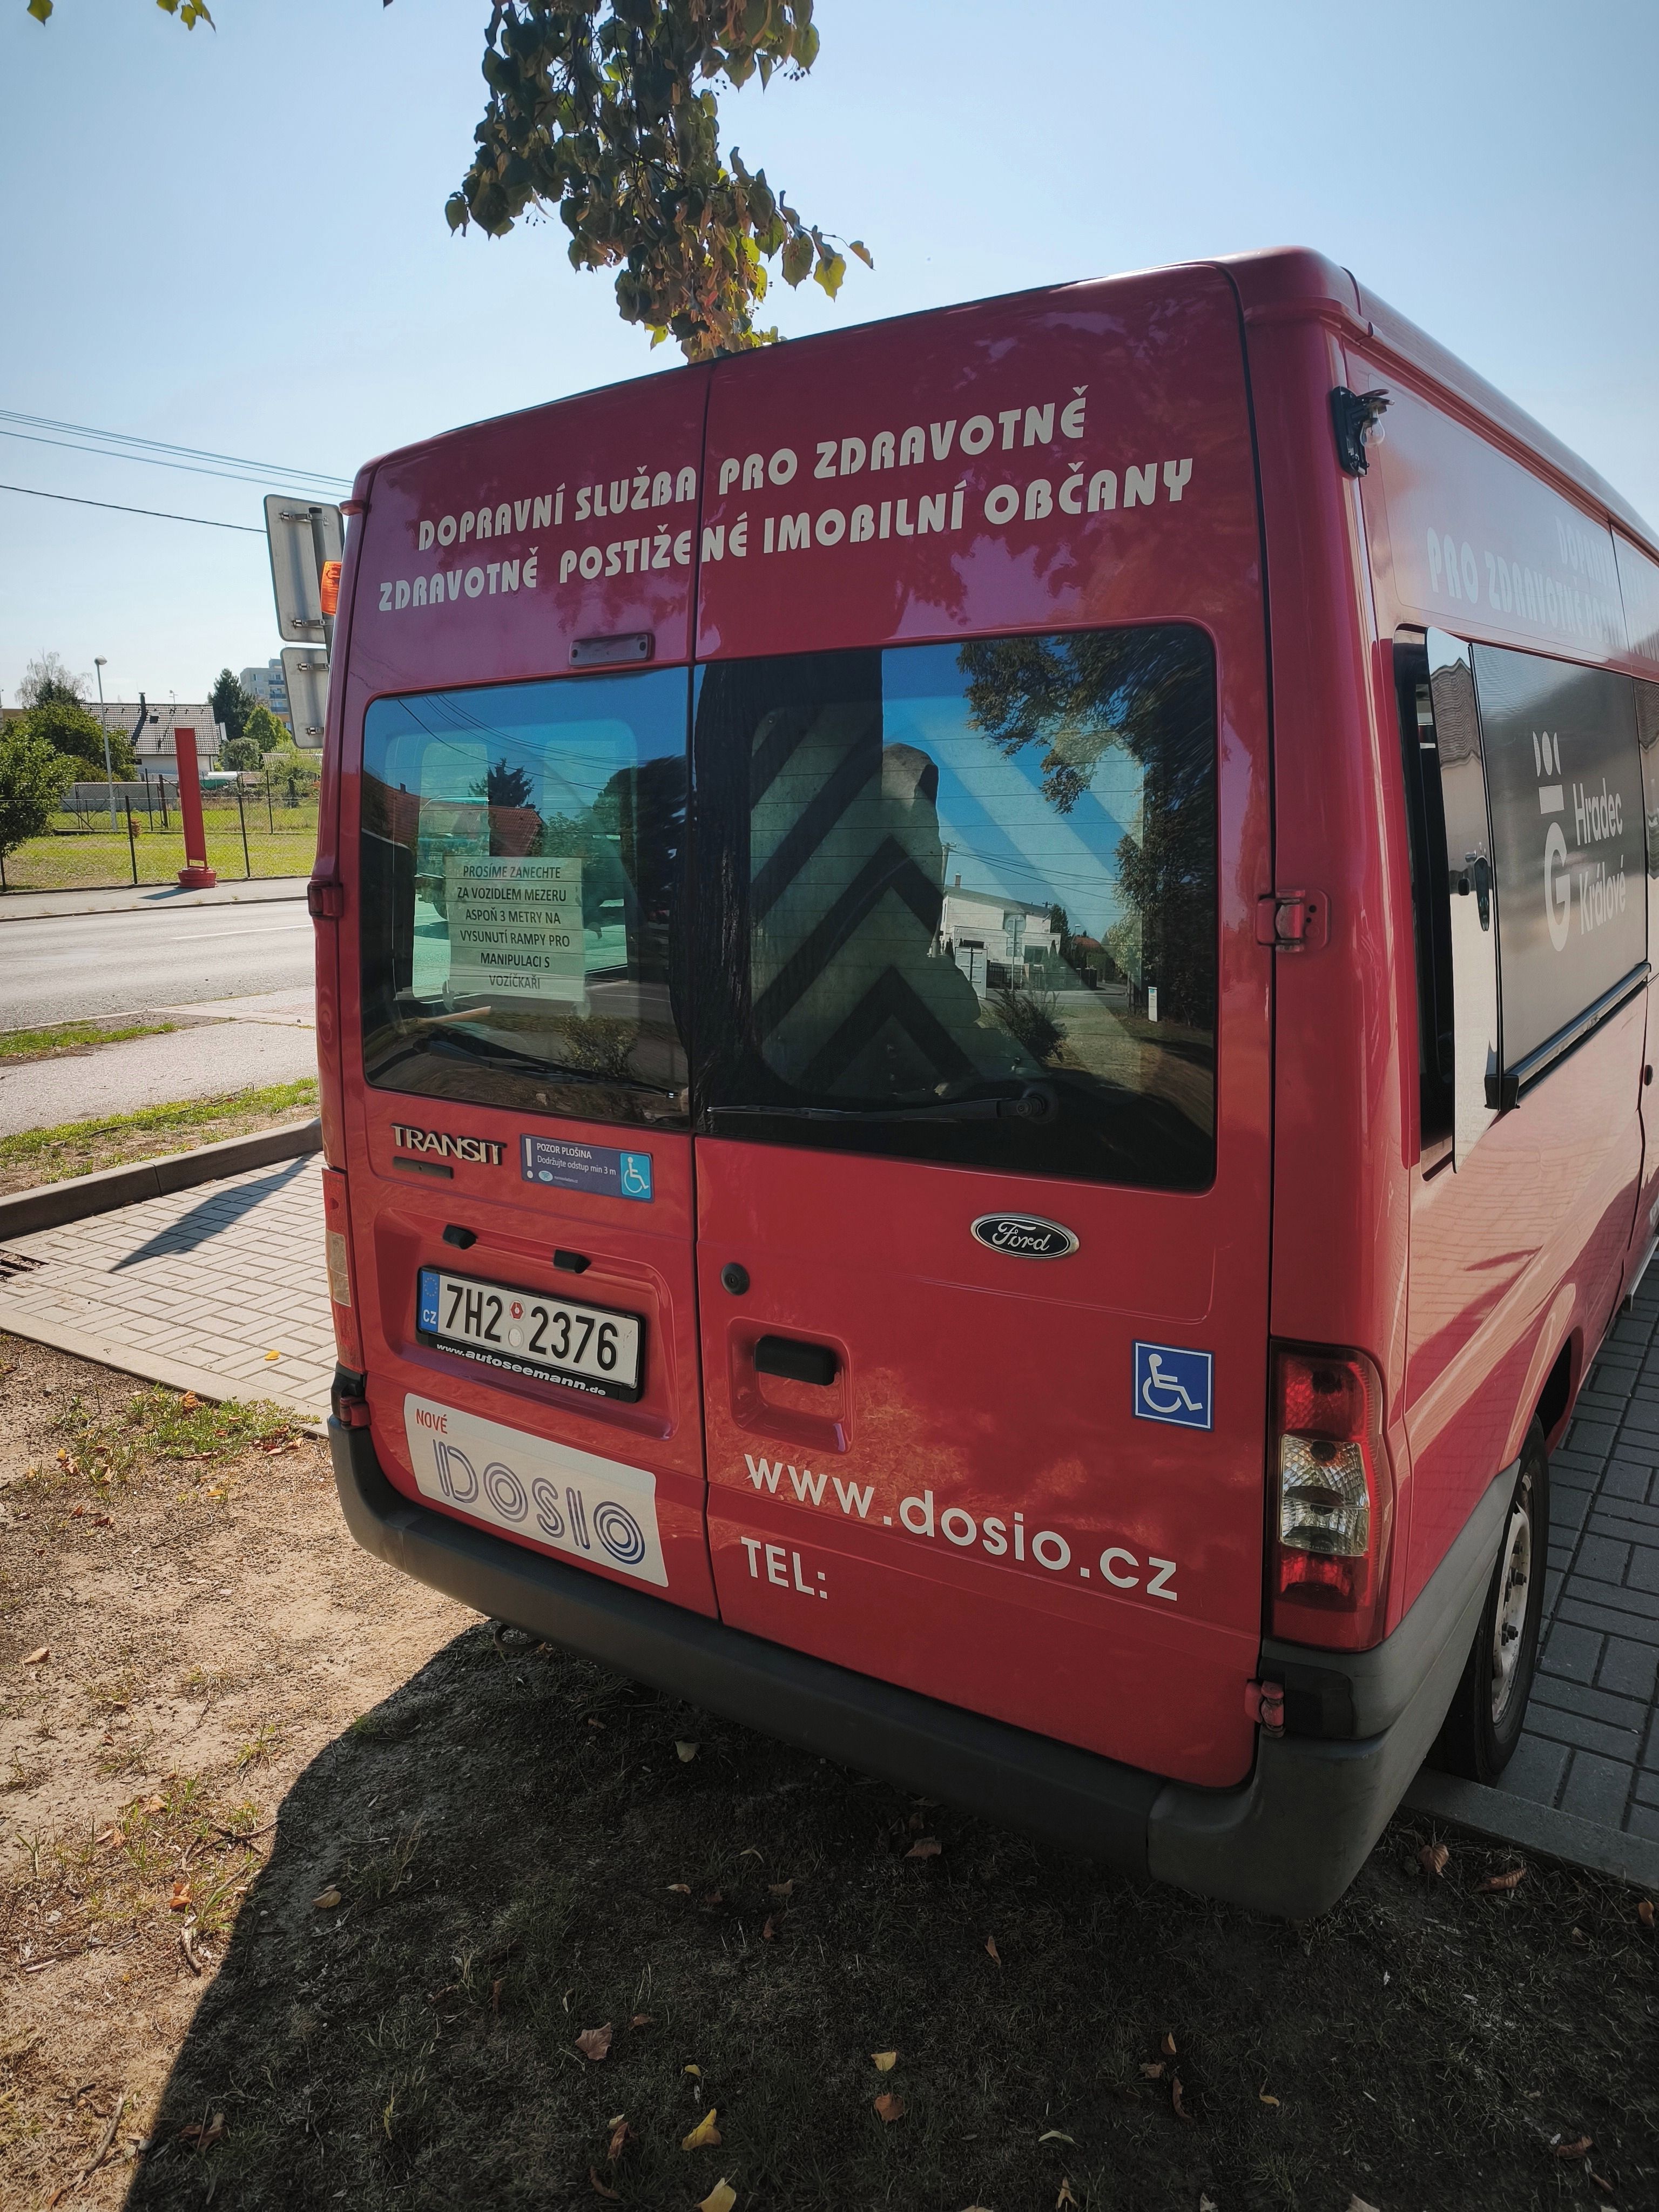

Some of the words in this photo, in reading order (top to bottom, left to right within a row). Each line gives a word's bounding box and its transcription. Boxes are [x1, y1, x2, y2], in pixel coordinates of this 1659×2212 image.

[419, 482, 565, 551] DOPRAVNÍ
[575, 465, 696, 522] SLUŽBA
[719, 448, 798, 495] PRO
[813, 385, 1089, 480] ZDRAVOTNĚ
[379, 547, 538, 611] ZDRAVOTNĚ
[559, 511, 748, 584] POSTIŽENÉ
[763, 479, 968, 554] IMOBILNÍ
[983, 457, 1193, 526] OBČANY
[1427, 527, 1479, 604] PRO
[1573, 777, 1623, 846] Hradec
[463, 864, 508, 878] PROSÍME
[510, 866, 561, 879] ZANECHTE
[457, 887, 469, 899] ZA
[471, 887, 521, 901] VOZIDLEM
[524, 889, 567, 902] MEZERU
[1579, 854, 1626, 935] Králové
[466, 907, 497, 921] ASPOŇ
[500, 910, 505, 922] 3
[509, 911, 542, 924] METRY
[545, 912, 561, 924] NA
[460, 929, 508, 944] VYSUNUTÍ
[510, 933, 546, 946] RAMPY
[549, 935, 570, 947] PRO
[481, 953, 541, 967] MANIPULACI
[544, 956, 550, 968] S
[489, 973, 540, 989] VOZÍČKAŘI
[391, 1124, 504, 1165] TRANSIT
[537, 1143, 561, 1154] POZOR
[562, 1147, 592, 1159] PLOŠINA
[537, 1155, 567, 1168] Dodržujte
[567, 1161, 589, 1172] odstup
[590, 1165, 602, 1174] min
[992, 1222, 1051, 1251] Ford
[423, 1310, 437, 1325] CZ
[446, 1284, 503, 1343] 7H2
[528, 1306, 618, 1371] 2376
[436, 1343, 606, 1395] www.autoseemann.de
[416, 1409, 448, 1434] NOVÉ
[433, 1439, 645, 1564] DOSIO
[744, 1453, 1178, 1601] www.dosio.cz
[740, 1536, 827, 1600] TEL:
